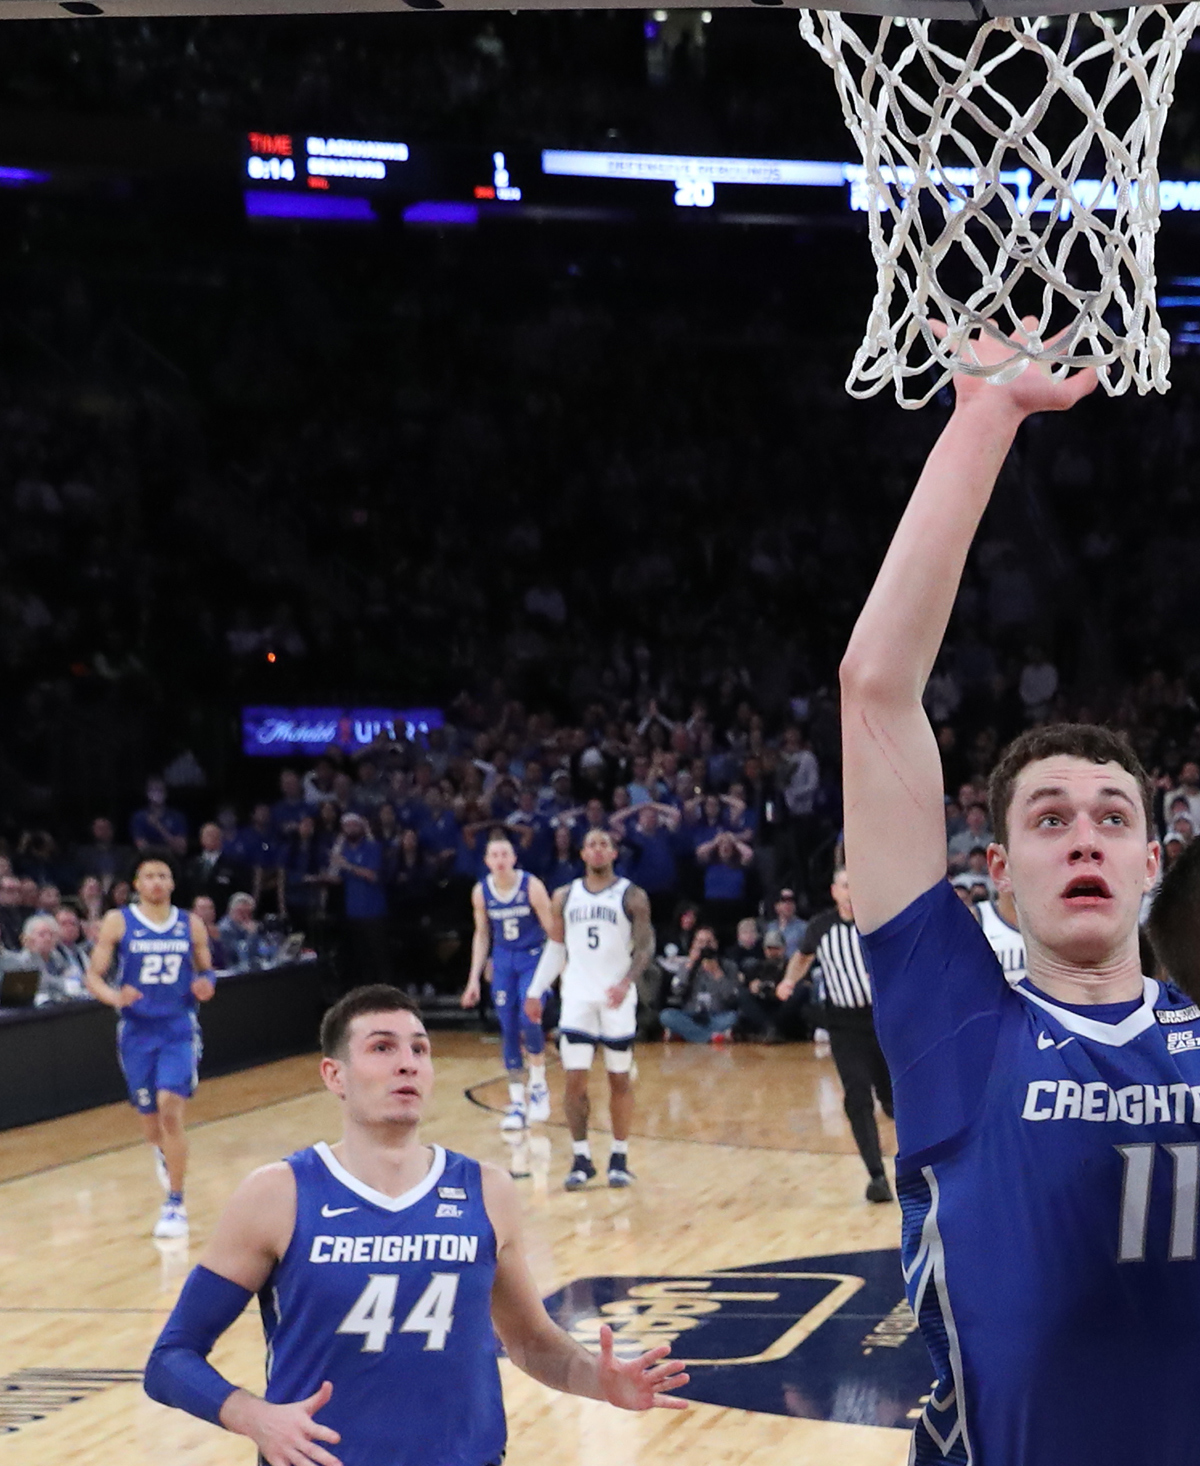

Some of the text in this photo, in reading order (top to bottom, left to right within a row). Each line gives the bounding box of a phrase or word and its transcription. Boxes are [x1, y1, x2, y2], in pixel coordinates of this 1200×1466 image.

[248, 131, 292, 155] TIME
[674, 178, 714, 207] 20
[502, 918, 520, 941] 5
[587, 926, 600, 950] 5
[140, 953, 183, 985] 23
[1167, 1030, 1194, 1042] BIG
[1112, 1142, 1200, 1263] 11
[309, 1234, 478, 1264] CREIGHTON
[335, 1272, 460, 1352] 44
